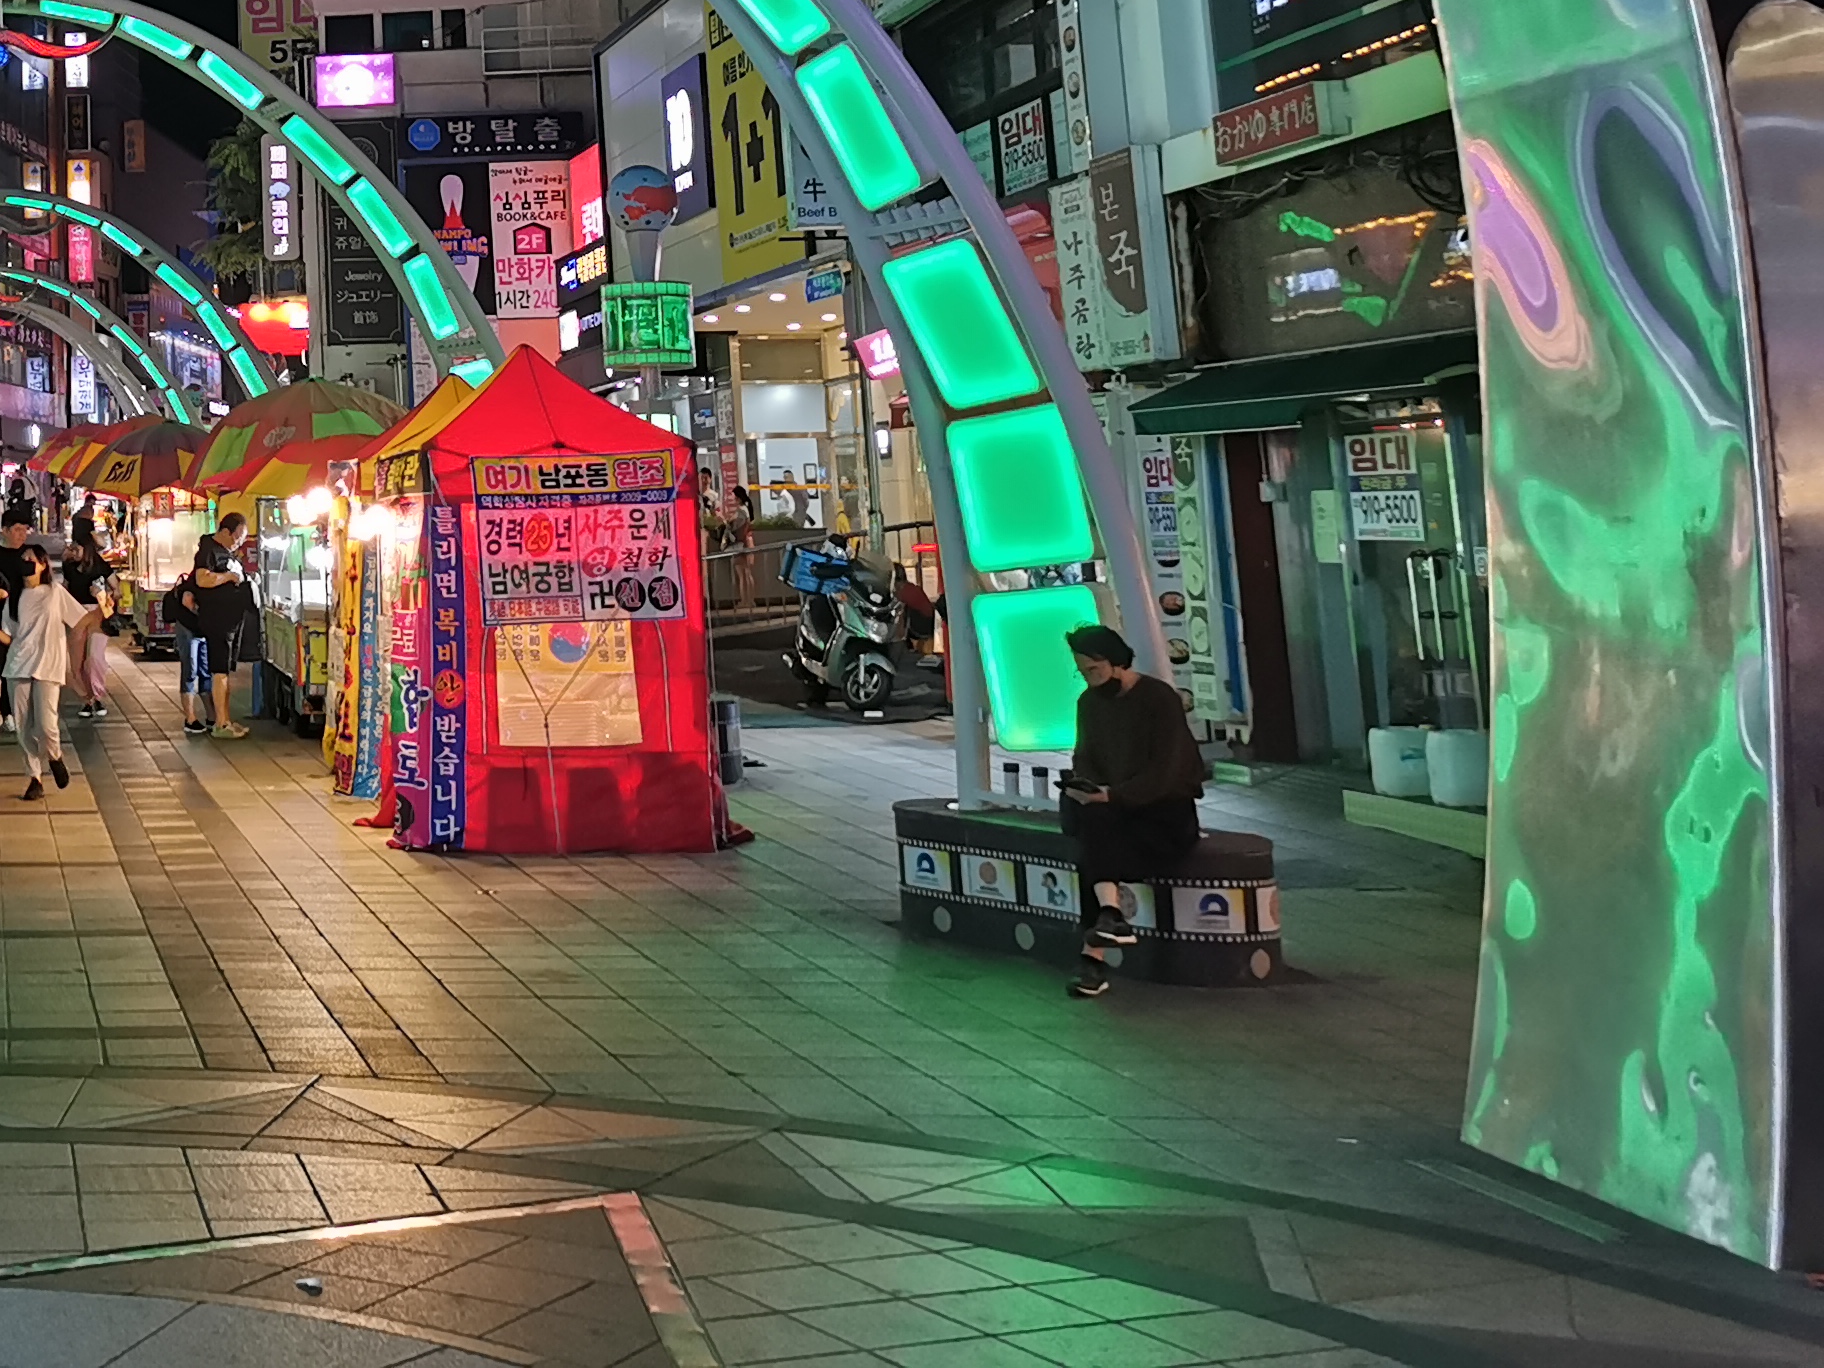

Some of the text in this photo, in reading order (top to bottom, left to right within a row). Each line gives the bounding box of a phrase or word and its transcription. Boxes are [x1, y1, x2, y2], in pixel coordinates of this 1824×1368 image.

[1001, 103, 1043, 149] 임대
[1216, 94, 1315, 153] おかゆ専門店
[721, 85, 787, 216] 1+1
[1004, 137, 1045, 174] 919-5500
[493, 189, 567, 211] 심심푸리
[496, 210, 567, 222] BOOK&CAFE
[797, 206, 825, 219] Beef
[433, 229, 472, 239] NAMPO
[516, 233, 544, 250] 2F
[1098, 183, 1139, 290] 본죽
[336, 290, 394, 303] ジュエリー
[495, 289, 530, 311] 1시간
[1062, 231, 1096, 360] 나주곰탕
[1348, 434, 1412, 473] 임대
[484, 457, 666, 491] 여기 남포동 원조
[484, 517, 525, 556] 경력
[578, 507, 672, 544] 사주 운세
[432, 505, 458, 599] 틀리면
[620, 546, 672, 574] 철학
[488, 559, 575, 596] 남여궁합
[434, 607, 460, 670] 복비
[433, 713, 461, 842] 받습니다
